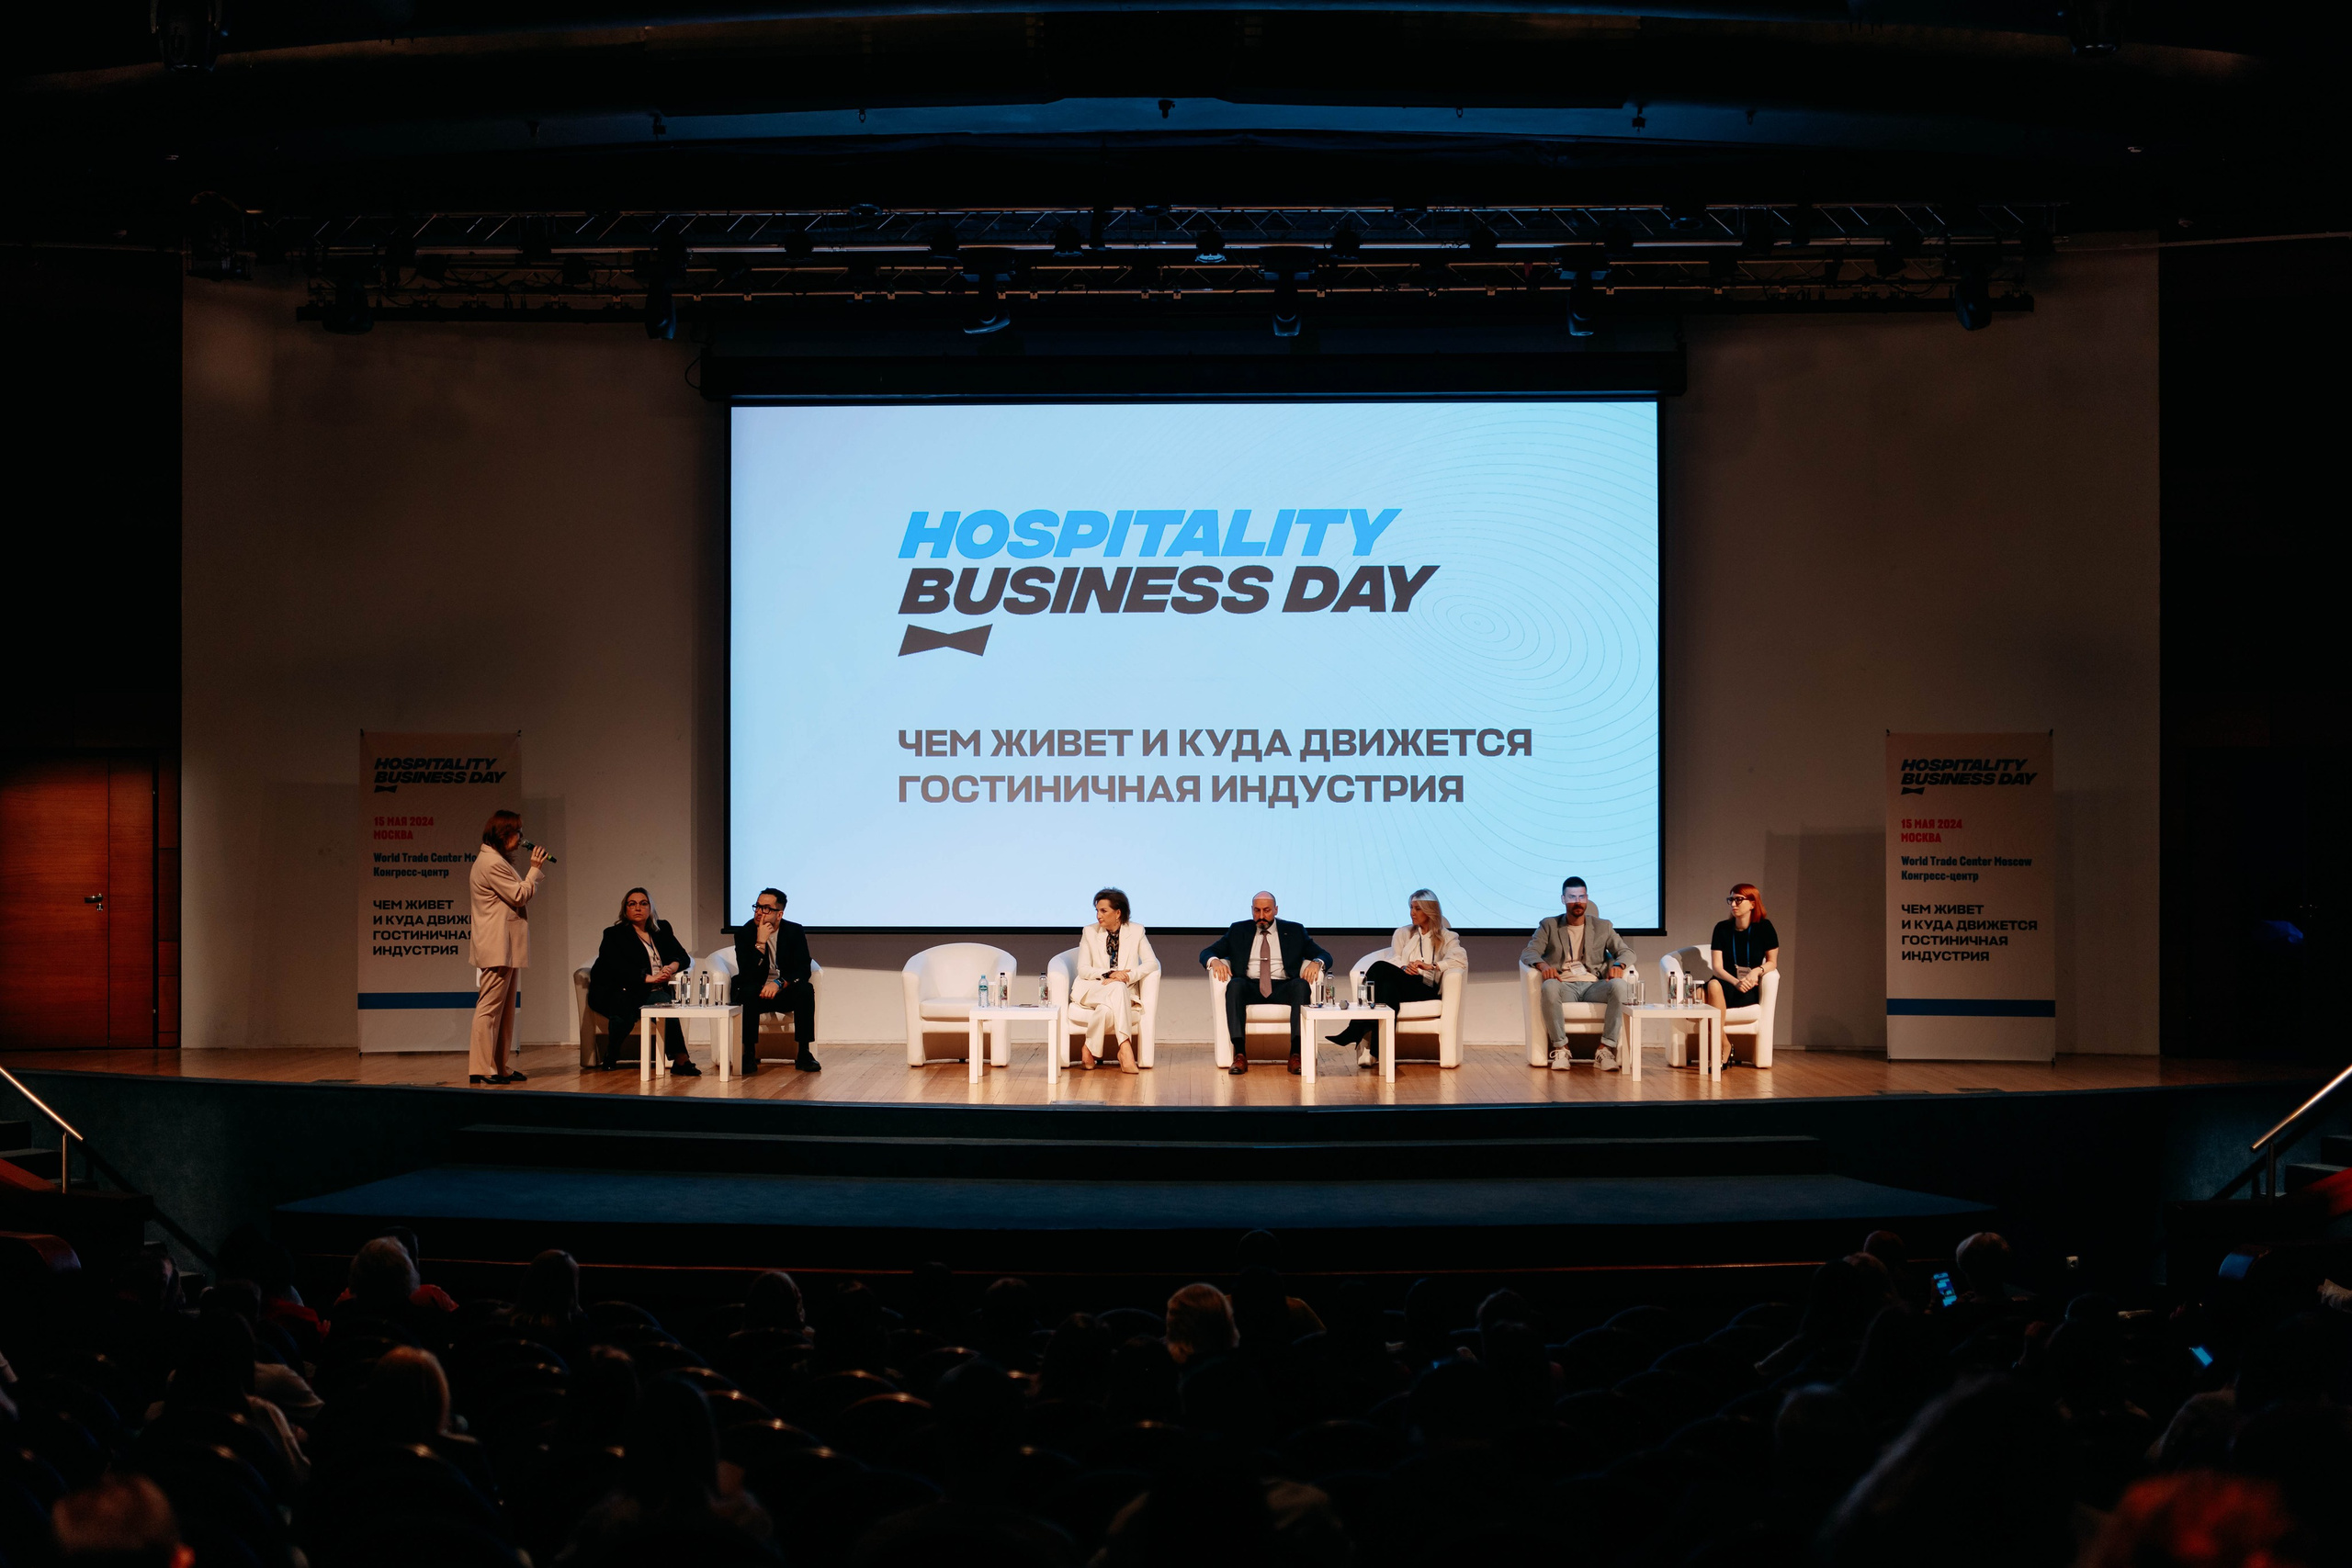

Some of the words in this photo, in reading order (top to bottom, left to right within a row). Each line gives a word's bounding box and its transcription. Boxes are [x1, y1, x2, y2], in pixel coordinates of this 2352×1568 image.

[898, 508, 1403, 559] HOSPITALITY
[898, 565, 1275, 615] BUSINESS
[1281, 565, 1442, 613] DAY
[897, 728, 982, 759] ЧЕМ
[989, 728, 1135, 759] ЖИВЕТ
[1141, 728, 1170, 759] И
[1178, 728, 1293, 763] КУДА
[1298, 728, 1534, 763] ДВИЖЕТСЯ
[374, 758, 498, 770] HOSPITALITY
[1901, 759, 2029, 772] HOSPITALITY
[374, 772, 467, 784] BUSINESS
[469, 772, 507, 784] DAY
[1901, 773, 1996, 785] BUSINESS
[1997, 773, 2038, 785] DAY
[897, 774, 1199, 805] ГОСТИНИЧНАЯ
[1210, 774, 1466, 810] ИНДУСТРИЯ
[374, 817, 385, 826] 15
[387, 817, 408, 826] МАЯ
[410, 817, 434, 826] 2024
[1901, 819, 1912, 829] 15
[1914, 819, 1935, 829] МАЯ
[1938, 819, 1962, 829] 2024
[374, 830, 413, 840] МОСКВА
[1901, 833, 1941, 842] МОСКВА
[373, 852, 400, 863] World
[402, 852, 429, 863] Trade
[431, 852, 462, 863] Center
[1901, 856, 1928, 866] World
[1930, 856, 1958, 866] Trade
[1960, 856, 1992, 866] Center
[1994, 856, 2032, 866] Moscow
[373, 867, 449, 878] Конгресс-центр
[1901, 871, 1979, 882] Конгресс-центр
[373, 900, 402, 909] ЧЕМ
[405, 900, 454, 909] ЖИВЕТ
[1901, 905, 1931, 914] ЧЕМ
[1934, 905, 1984, 914] ЖИВЕТ
[373, 916, 382, 925] И
[385, 916, 424, 927] КУДА
[426, 916, 471, 927] ДВИЖ
[1901, 920, 1911, 930] И
[1914, 920, 1954, 931] КУДА
[1956, 920, 2038, 931] ДВИЖЕТСЯ
[1901, 935, 2008, 945] ГОСТИНИЧНАЯ
[373, 946, 458, 957] ИНДУСТРИЯ
[1901, 951, 1989, 962] ИНДУСТРИЯ
